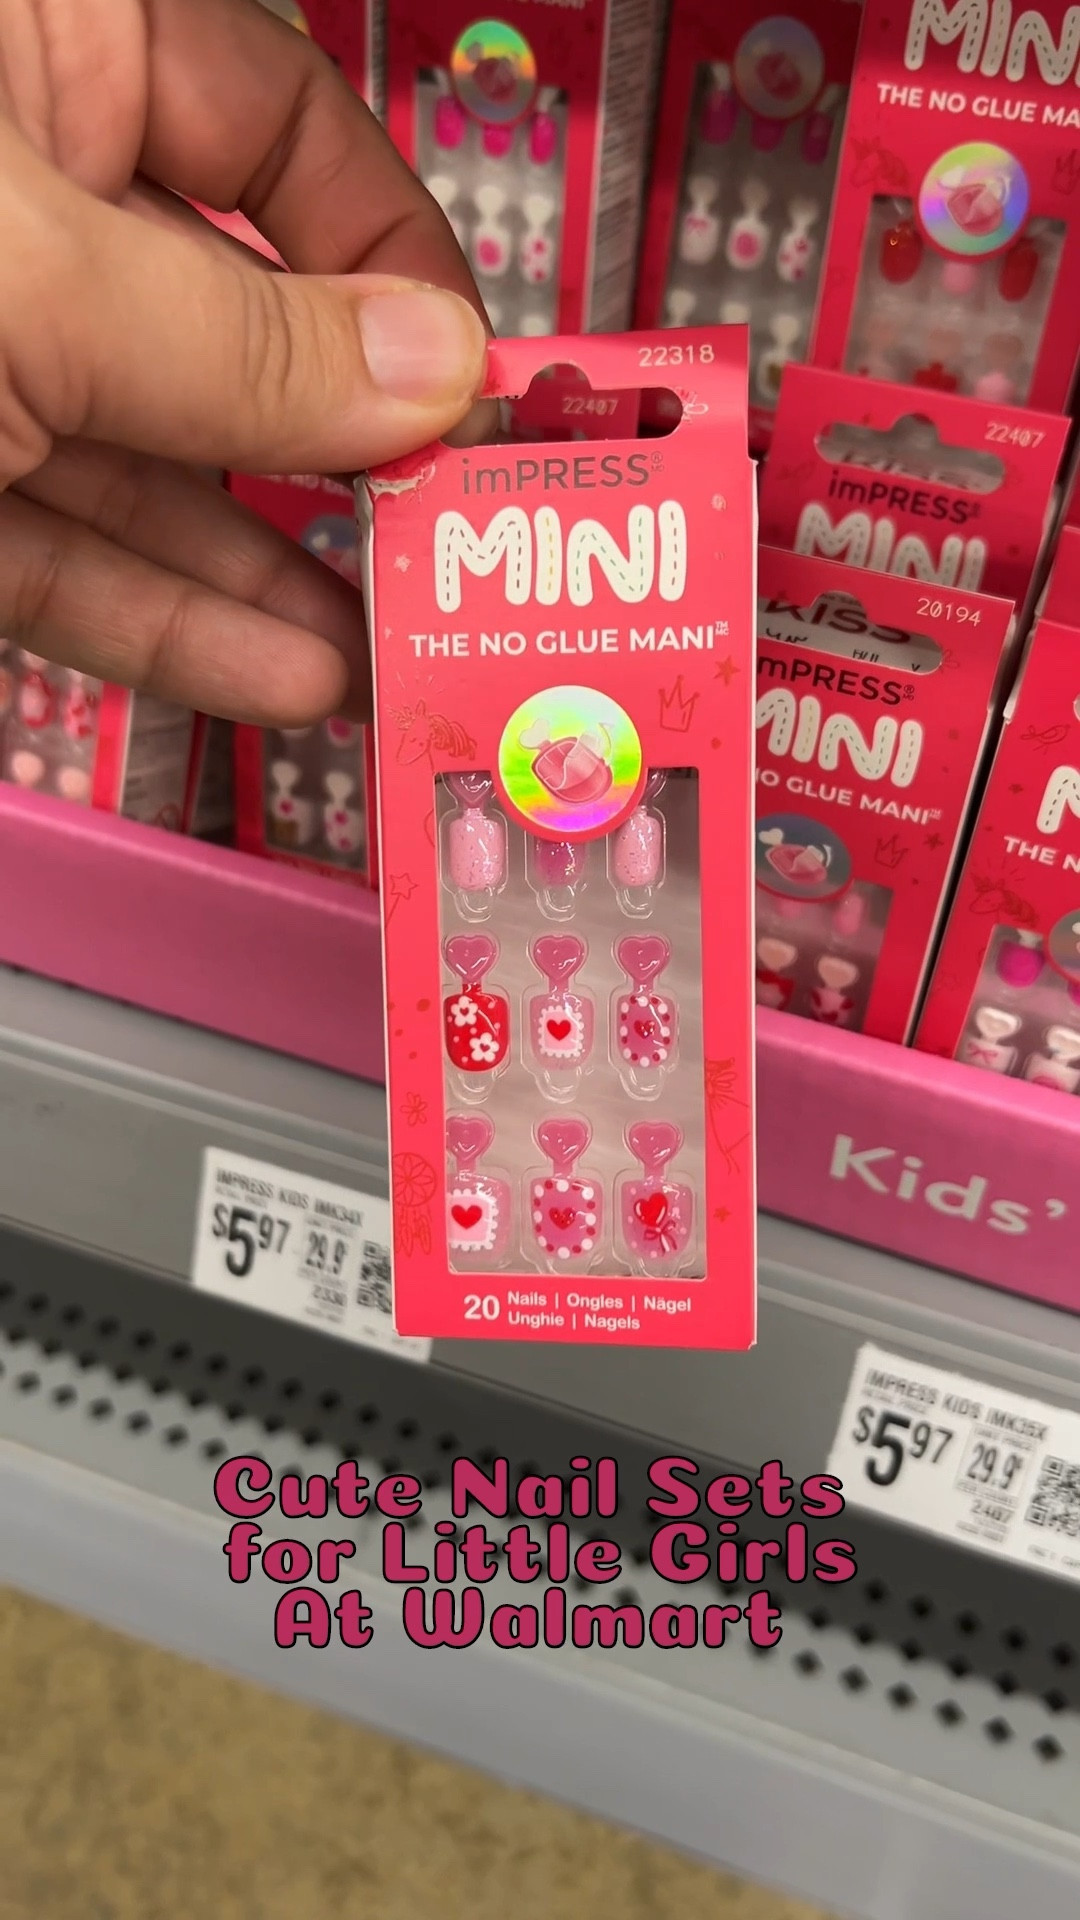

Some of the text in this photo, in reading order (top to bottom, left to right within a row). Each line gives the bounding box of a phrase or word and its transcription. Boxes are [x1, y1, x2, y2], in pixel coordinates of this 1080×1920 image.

[904, 0, 1080, 87] MIN
[877, 82, 922, 108] THE
[928, 90, 967, 114] NO
[971, 95, 1036, 124] GLUE
[638, 344, 715, 367] 22318
[984, 421, 1047, 448] 22407
[434, 499, 687, 613] MINI
[793, 502, 987, 593] MINI
[916, 597, 981, 628] 20194
[408, 633, 469, 657] THE
[480, 631, 527, 656] NO
[536, 628, 619, 655] GLUE
[786, 777, 853, 807] GLUE
[1004, 835, 1057, 866] THE
[463, 1294, 500, 1321] 20
[508, 1291, 547, 1306] Nails
[566, 1292, 623, 1311] Ongles
[643, 1295, 691, 1314] Nägel
[508, 1311, 565, 1328] Unghie
[584, 1313, 640, 1332] Nagels
[866, 1368, 940, 1405] IMPRESS
[942, 1392, 985, 1420] KIDS
